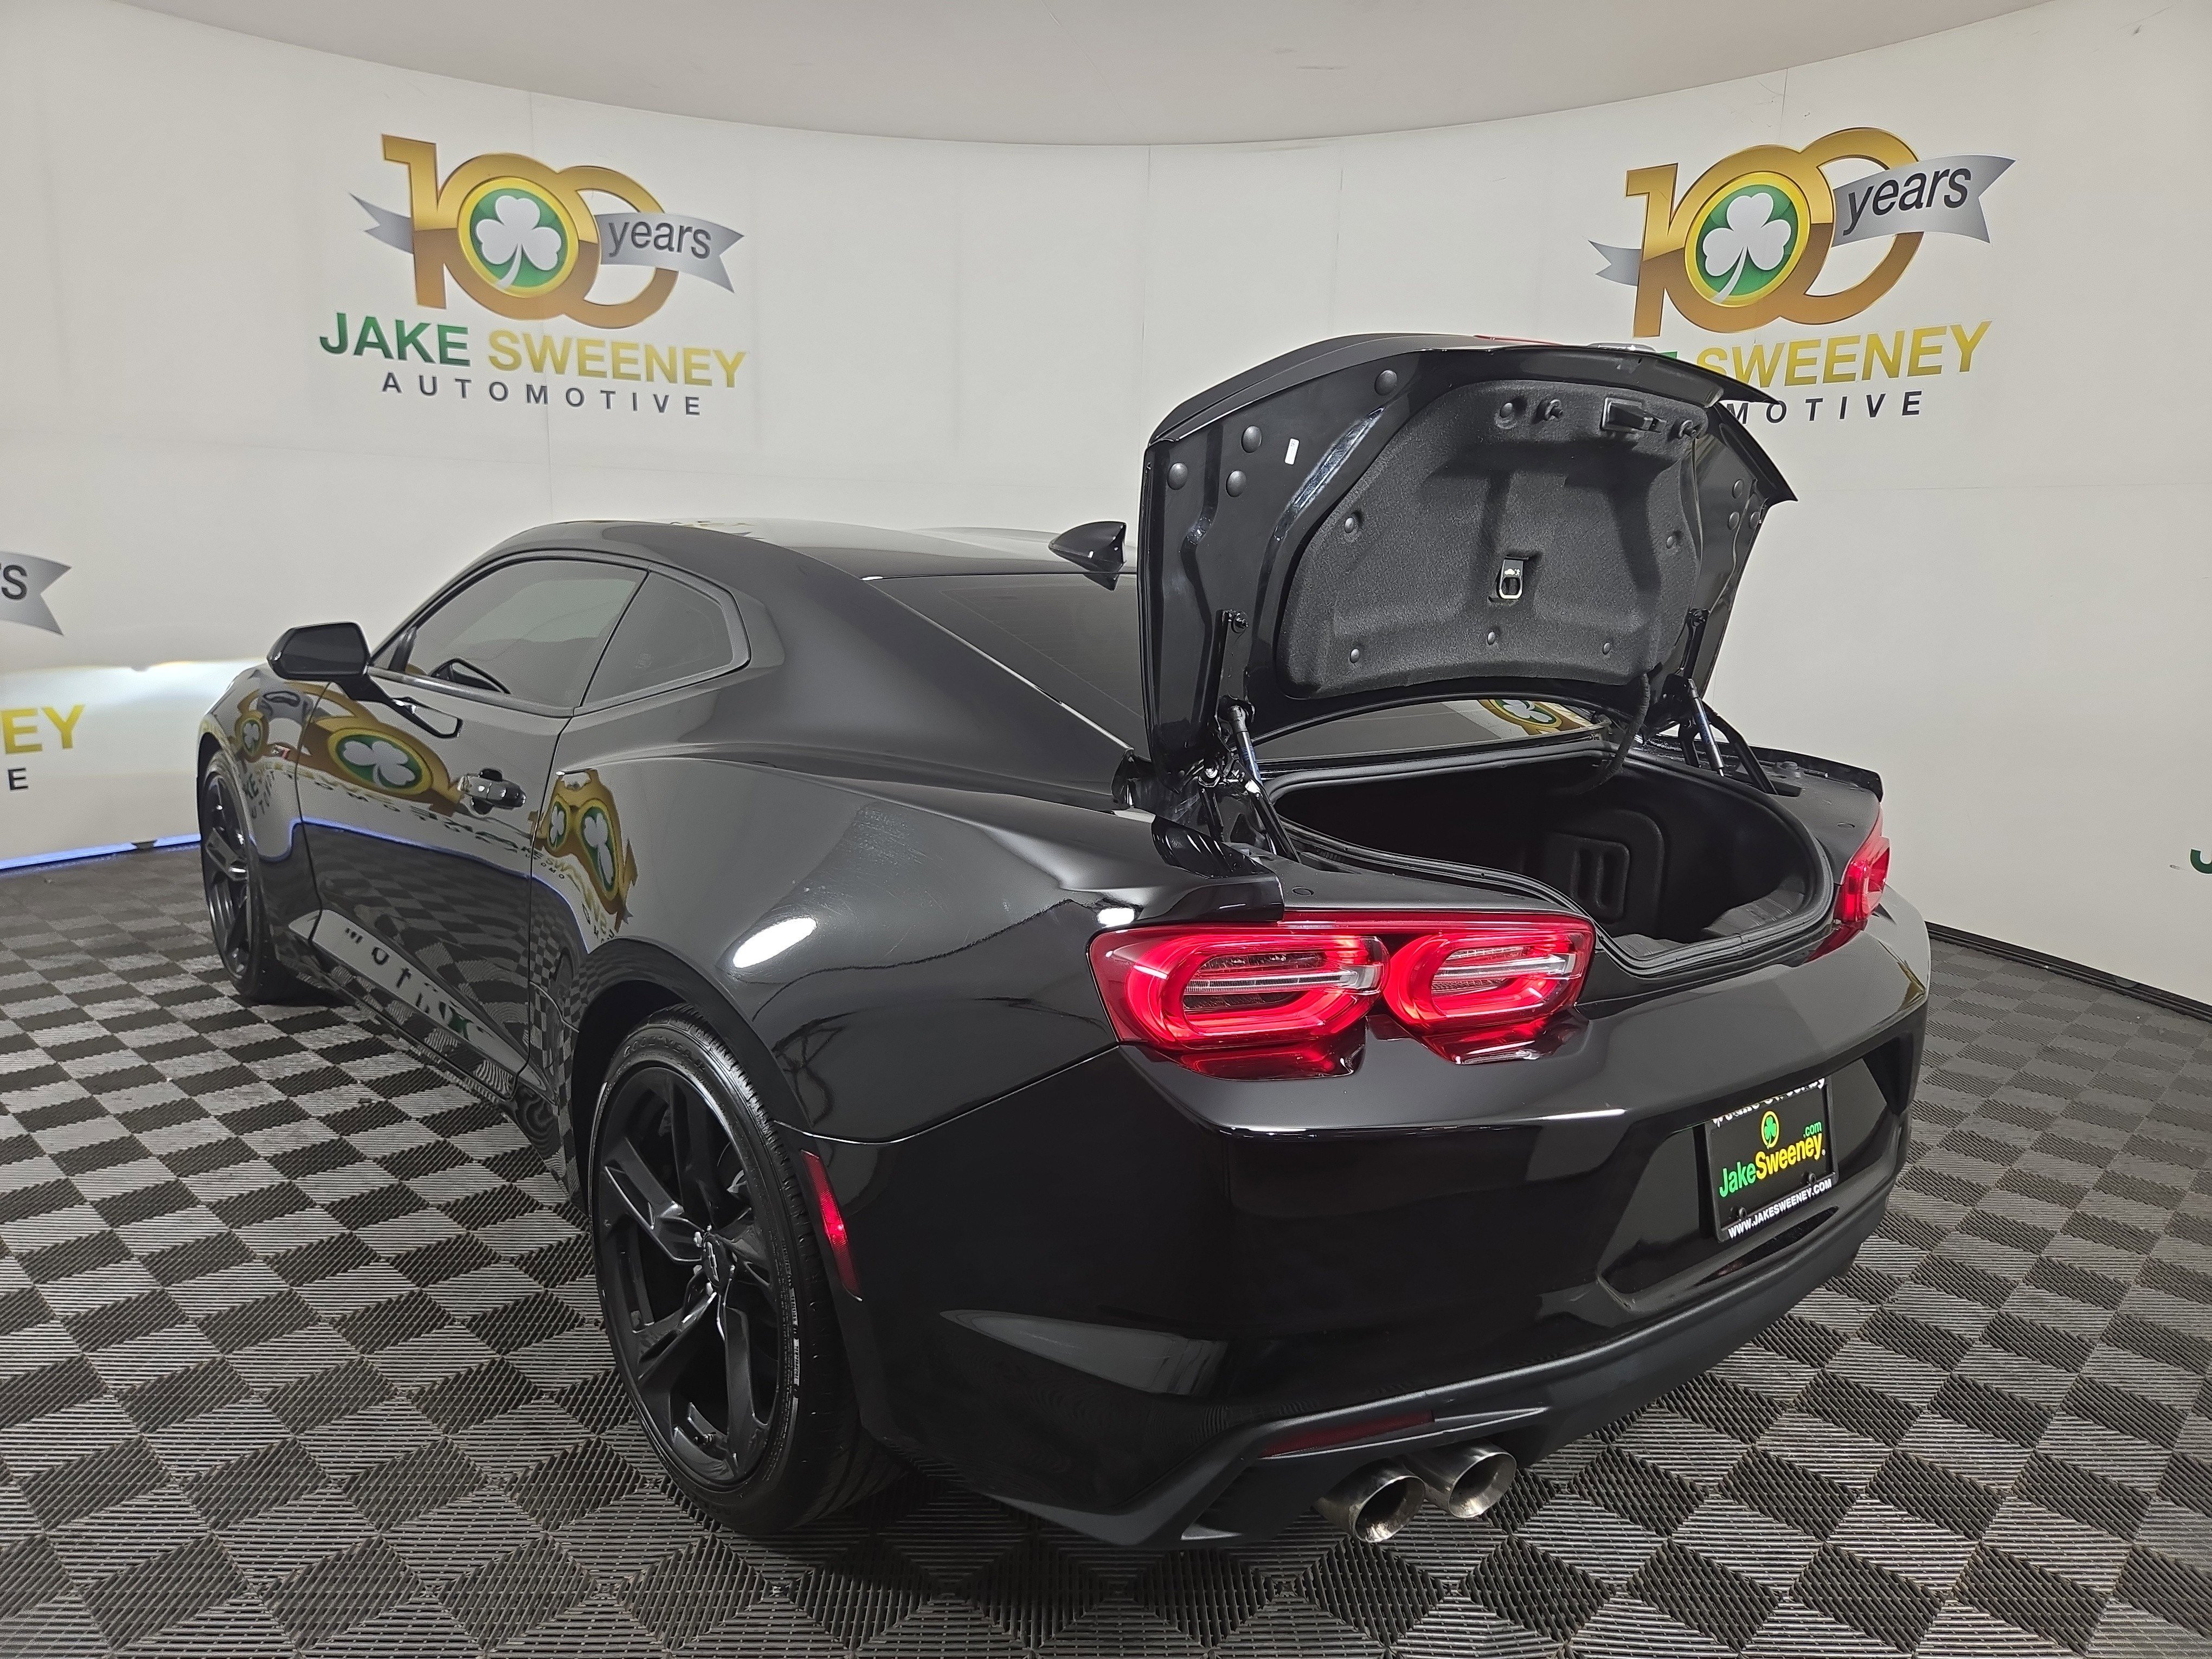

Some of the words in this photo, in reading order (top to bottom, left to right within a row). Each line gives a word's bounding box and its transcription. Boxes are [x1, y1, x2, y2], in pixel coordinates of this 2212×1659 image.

[1842, 168, 1972, 236] years
[607, 218, 712, 259] years
[319, 311, 471, 367] JAKE
[488, 330, 749, 388] SWEENEY
[1697, 320, 1994, 389] SWEENEY
[382, 371, 701, 416] AUTOMOTIVE
[1727, 390, 1923, 427] MOTIVE
[1728, 1178, 1832, 1239] WWW.JAKESWEENEY.COM
